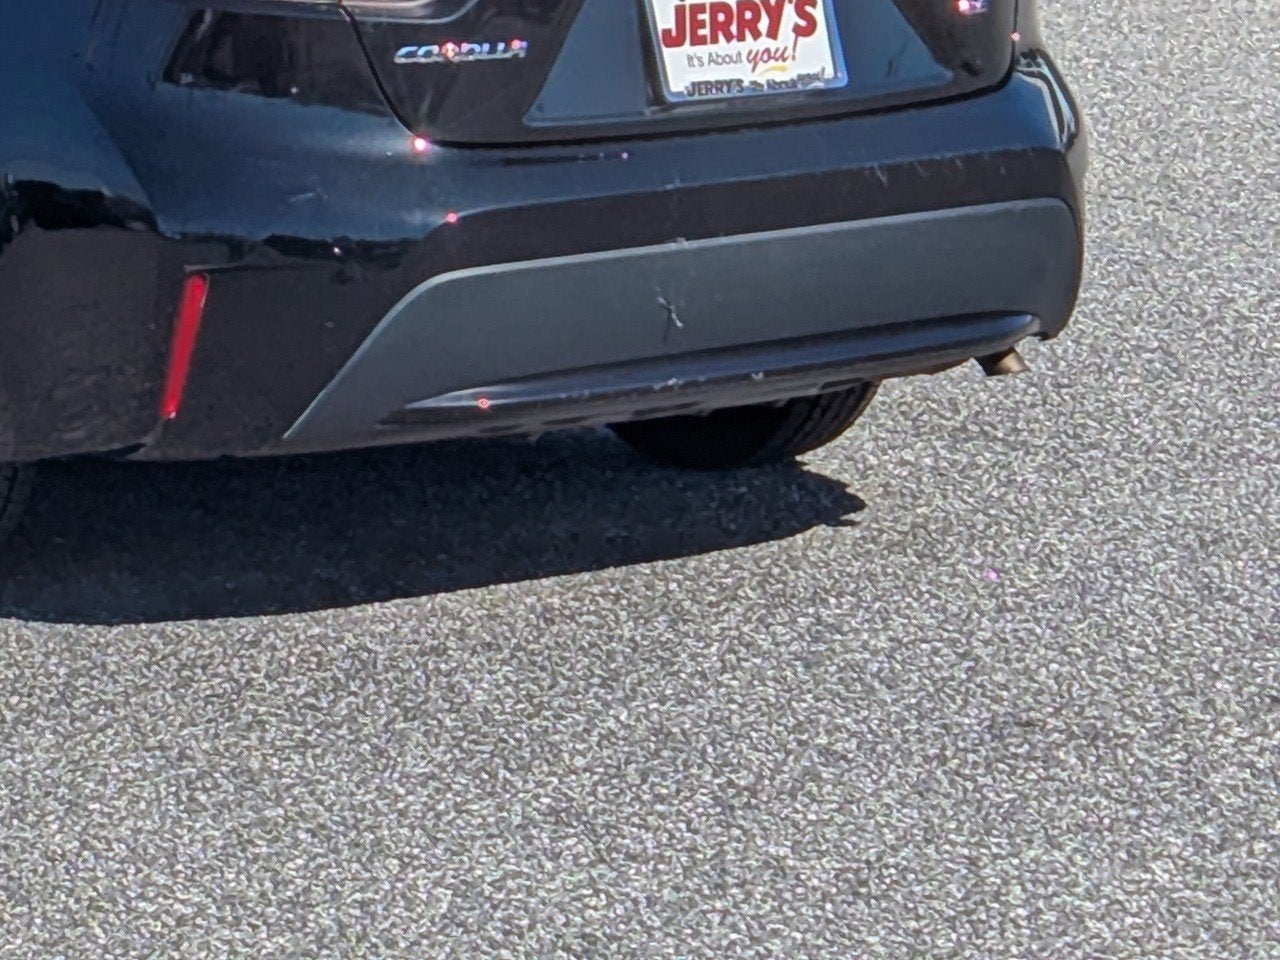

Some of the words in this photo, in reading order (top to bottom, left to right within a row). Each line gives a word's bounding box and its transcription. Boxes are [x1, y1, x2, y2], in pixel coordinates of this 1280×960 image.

[686, 52, 705, 68] It's
[707, 50, 743, 66] About
[746, 37, 797, 74] you!
[685, 78, 745, 97] JERRY'S
